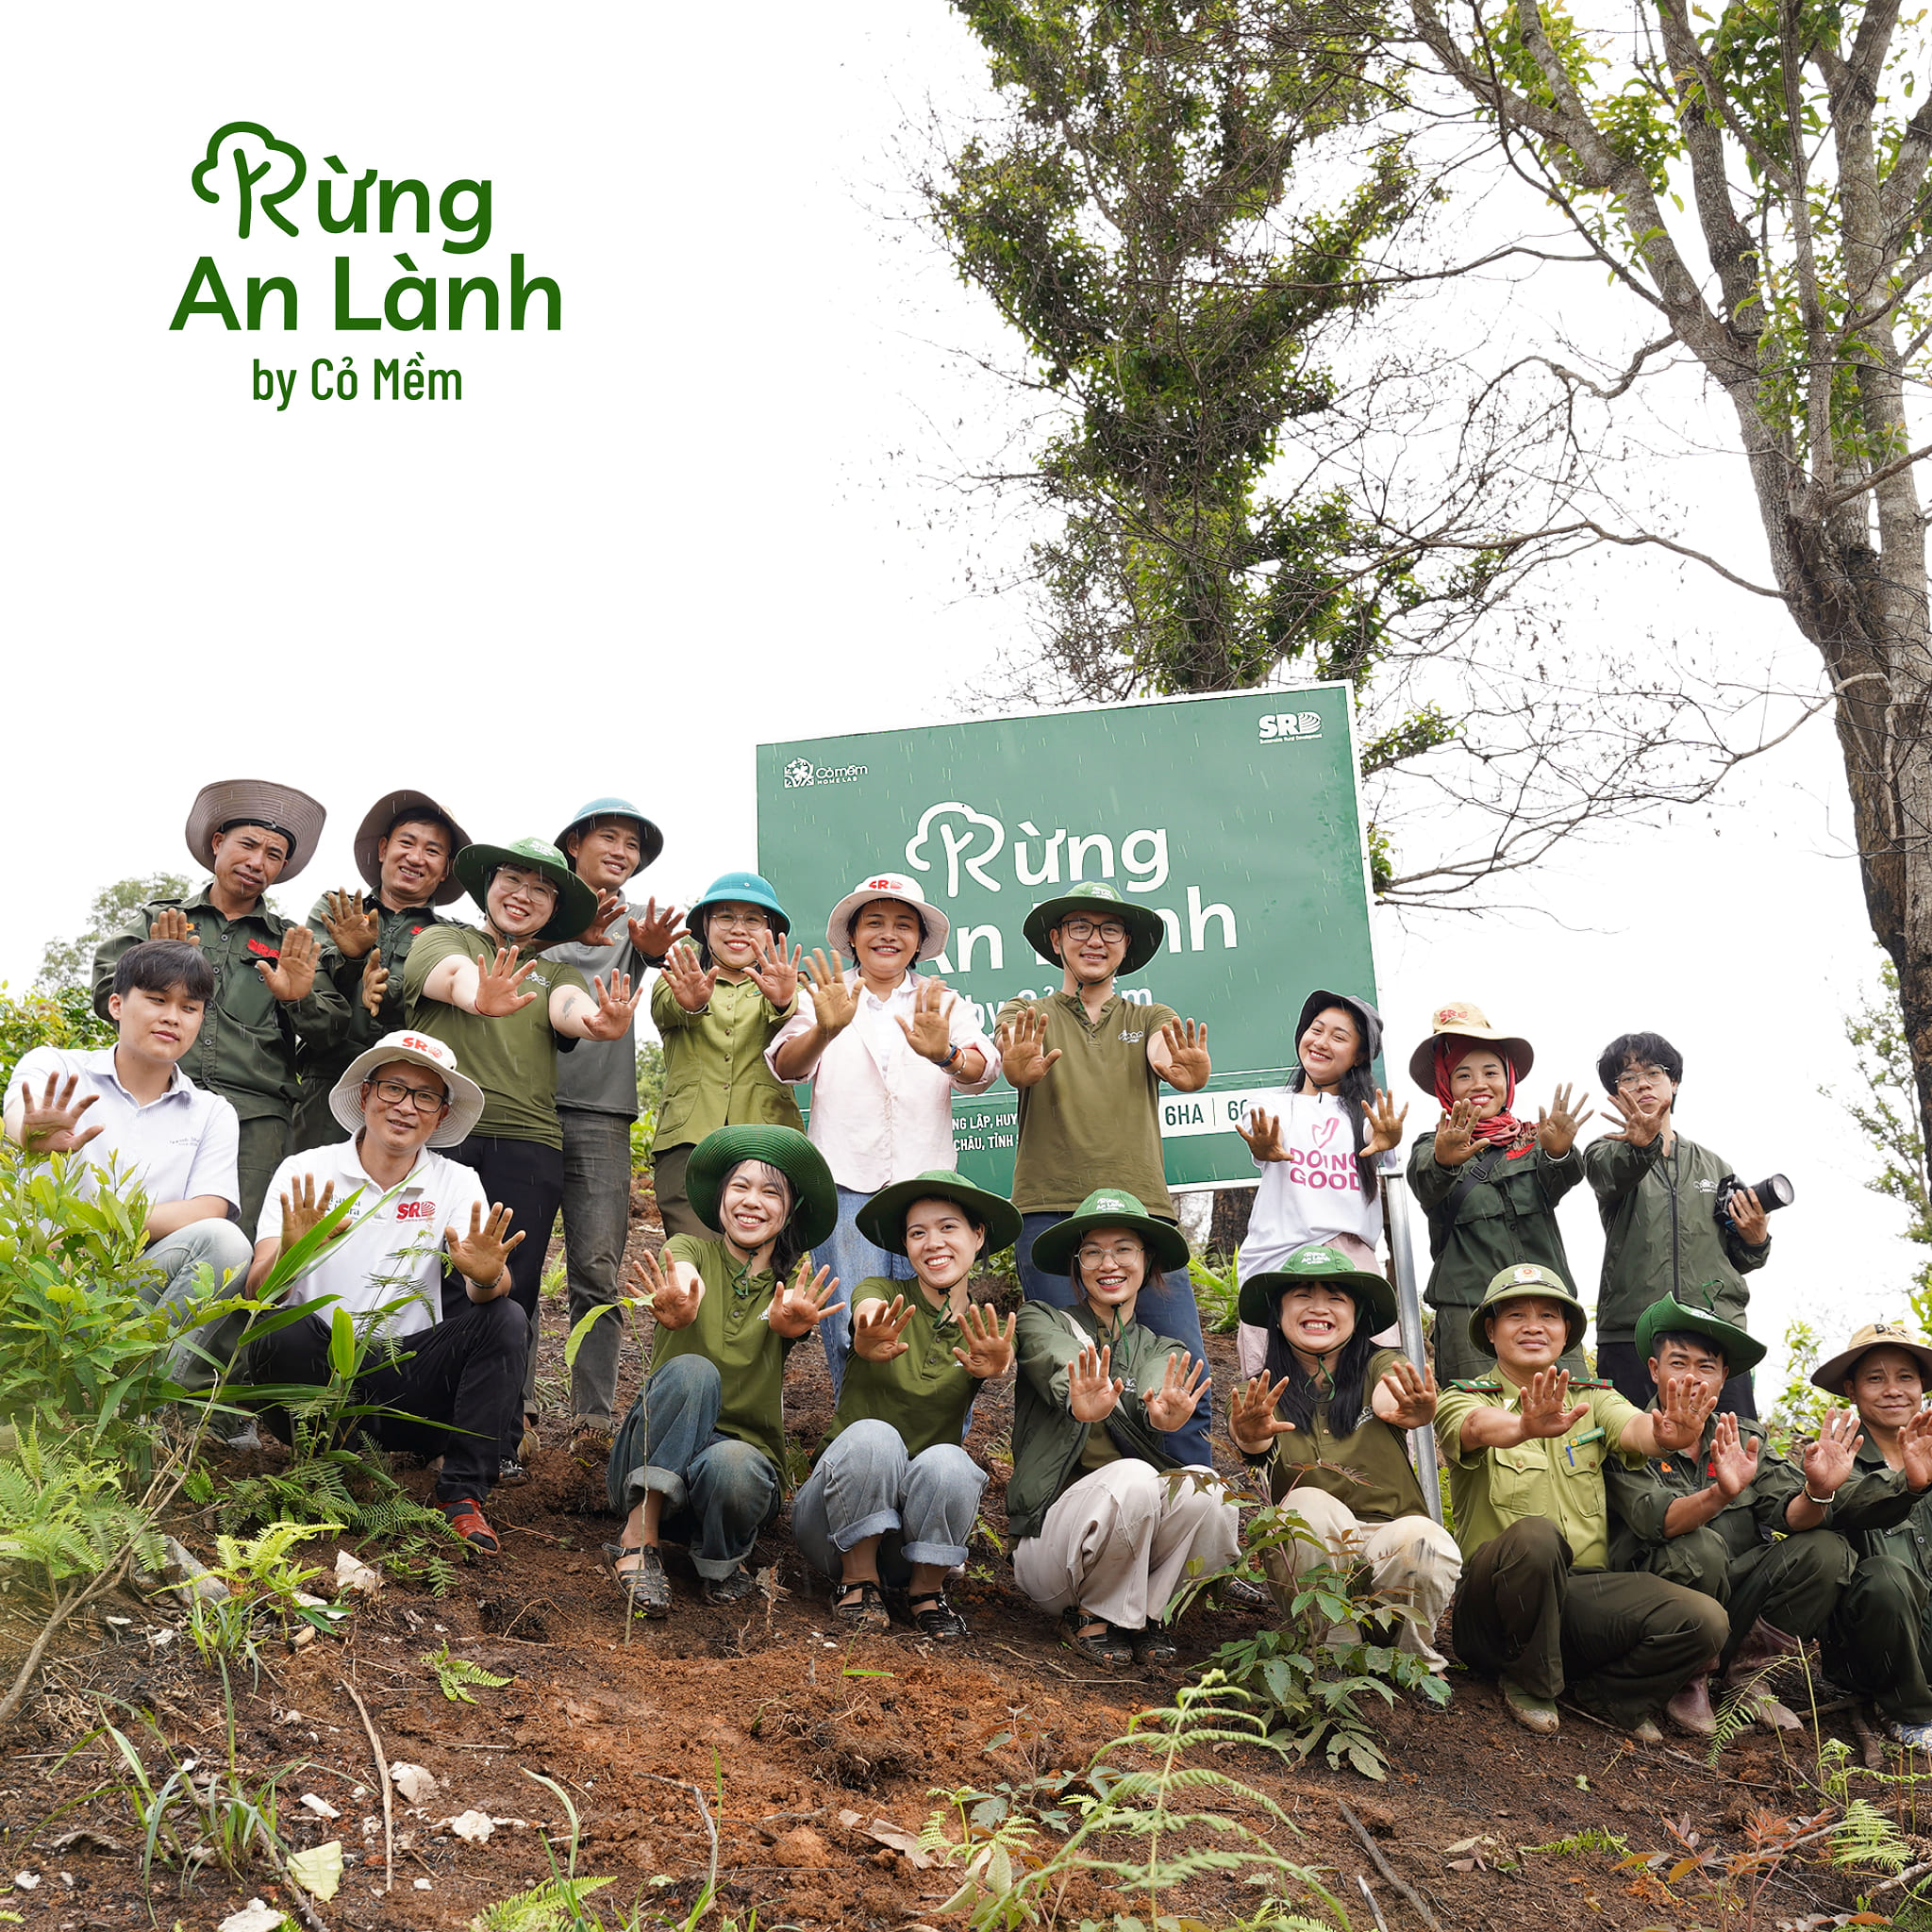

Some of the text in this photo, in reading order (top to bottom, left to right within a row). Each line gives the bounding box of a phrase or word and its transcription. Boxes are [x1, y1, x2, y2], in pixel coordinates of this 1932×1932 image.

[905, 802, 1170, 897] Rừng
[952, 1113, 1018, 1131] NG LẬP, HUY
[1165, 1103, 1204, 1125] 6HA
[953, 1135, 985, 1151] CHÂU,
[988, 1132, 1013, 1148] TỈNH
